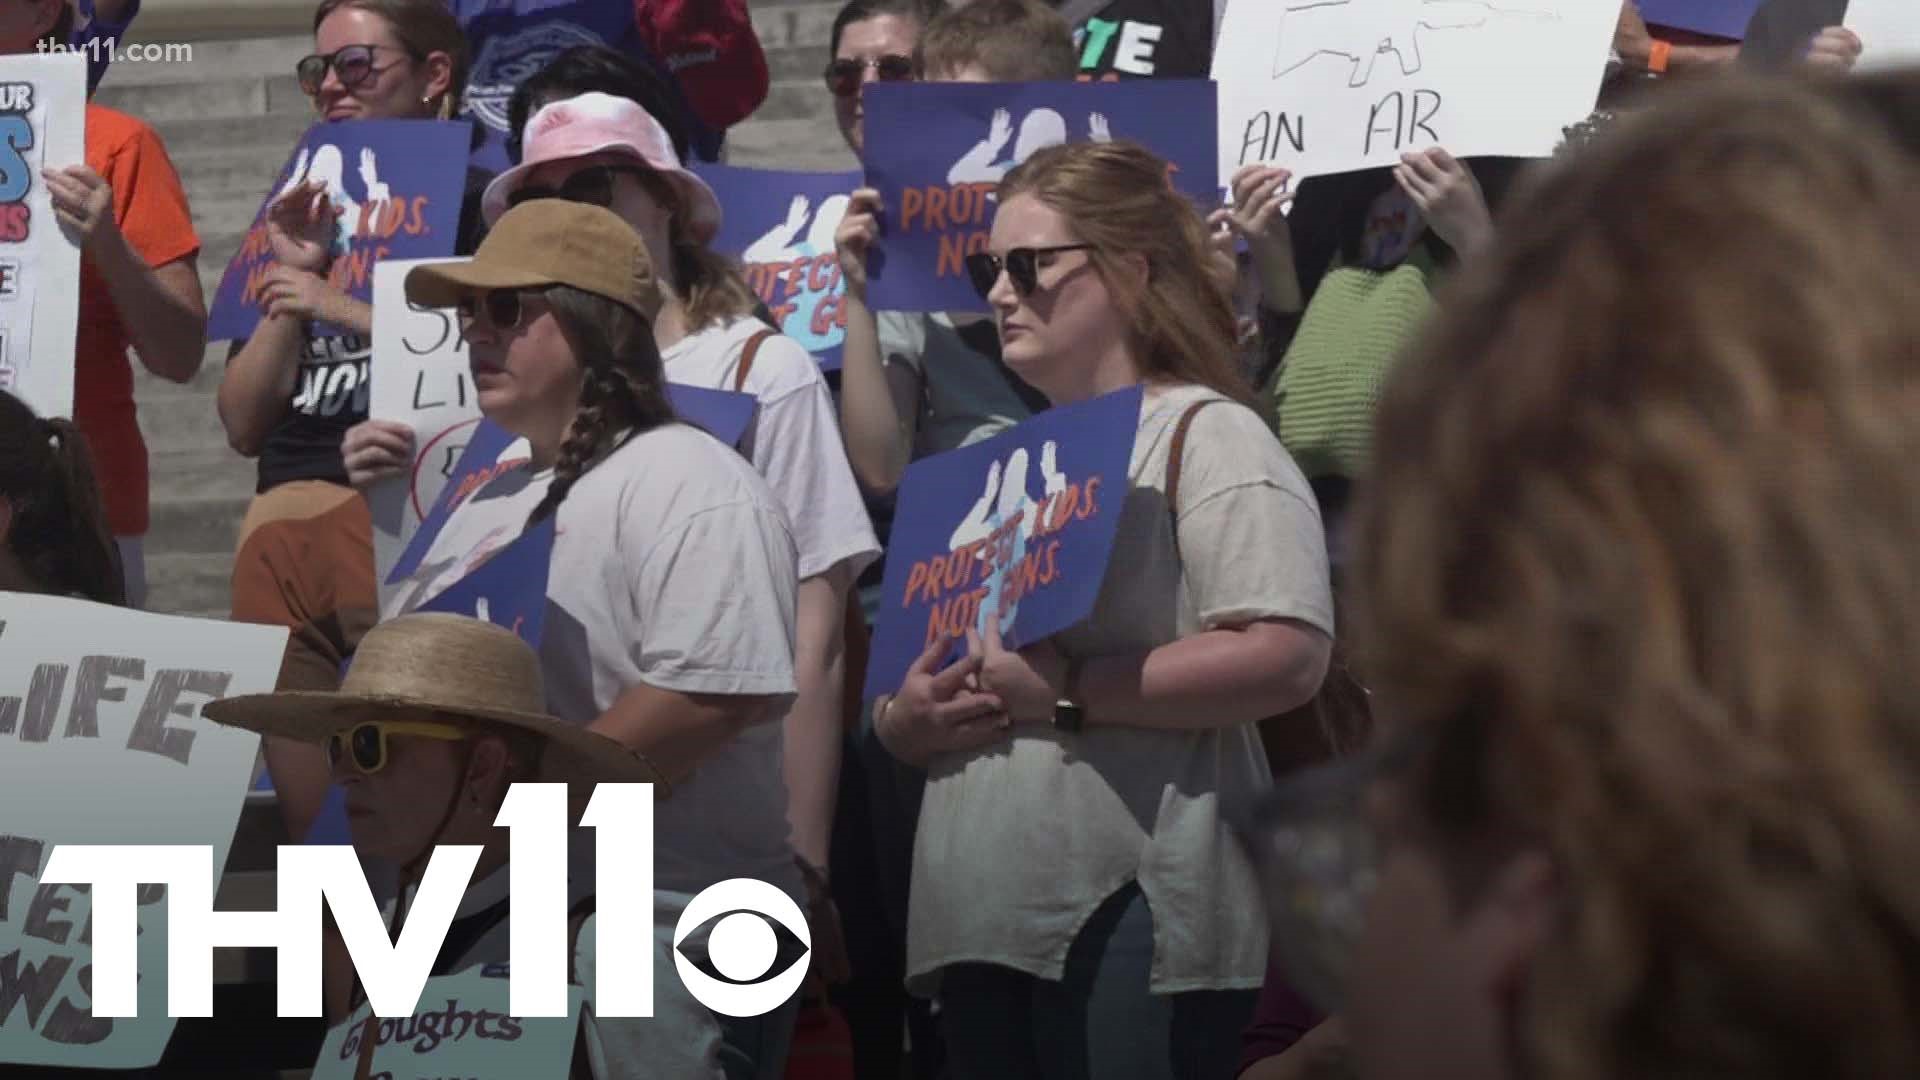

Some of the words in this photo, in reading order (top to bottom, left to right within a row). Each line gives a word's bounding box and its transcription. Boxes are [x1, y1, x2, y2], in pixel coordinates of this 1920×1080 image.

[1073, 17, 1163, 75] TE
[1239, 110, 1305, 166] AN
[1363, 88, 1442, 156] AR
[902, 182, 1001, 231] PROT
[412, 369, 466, 410] LI
[903, 509, 1025, 608] PROTECT
[1032, 476, 1102, 541] KIDS.
[924, 586, 991, 650] NOT
[339, 1000, 533, 1060] Toughts
